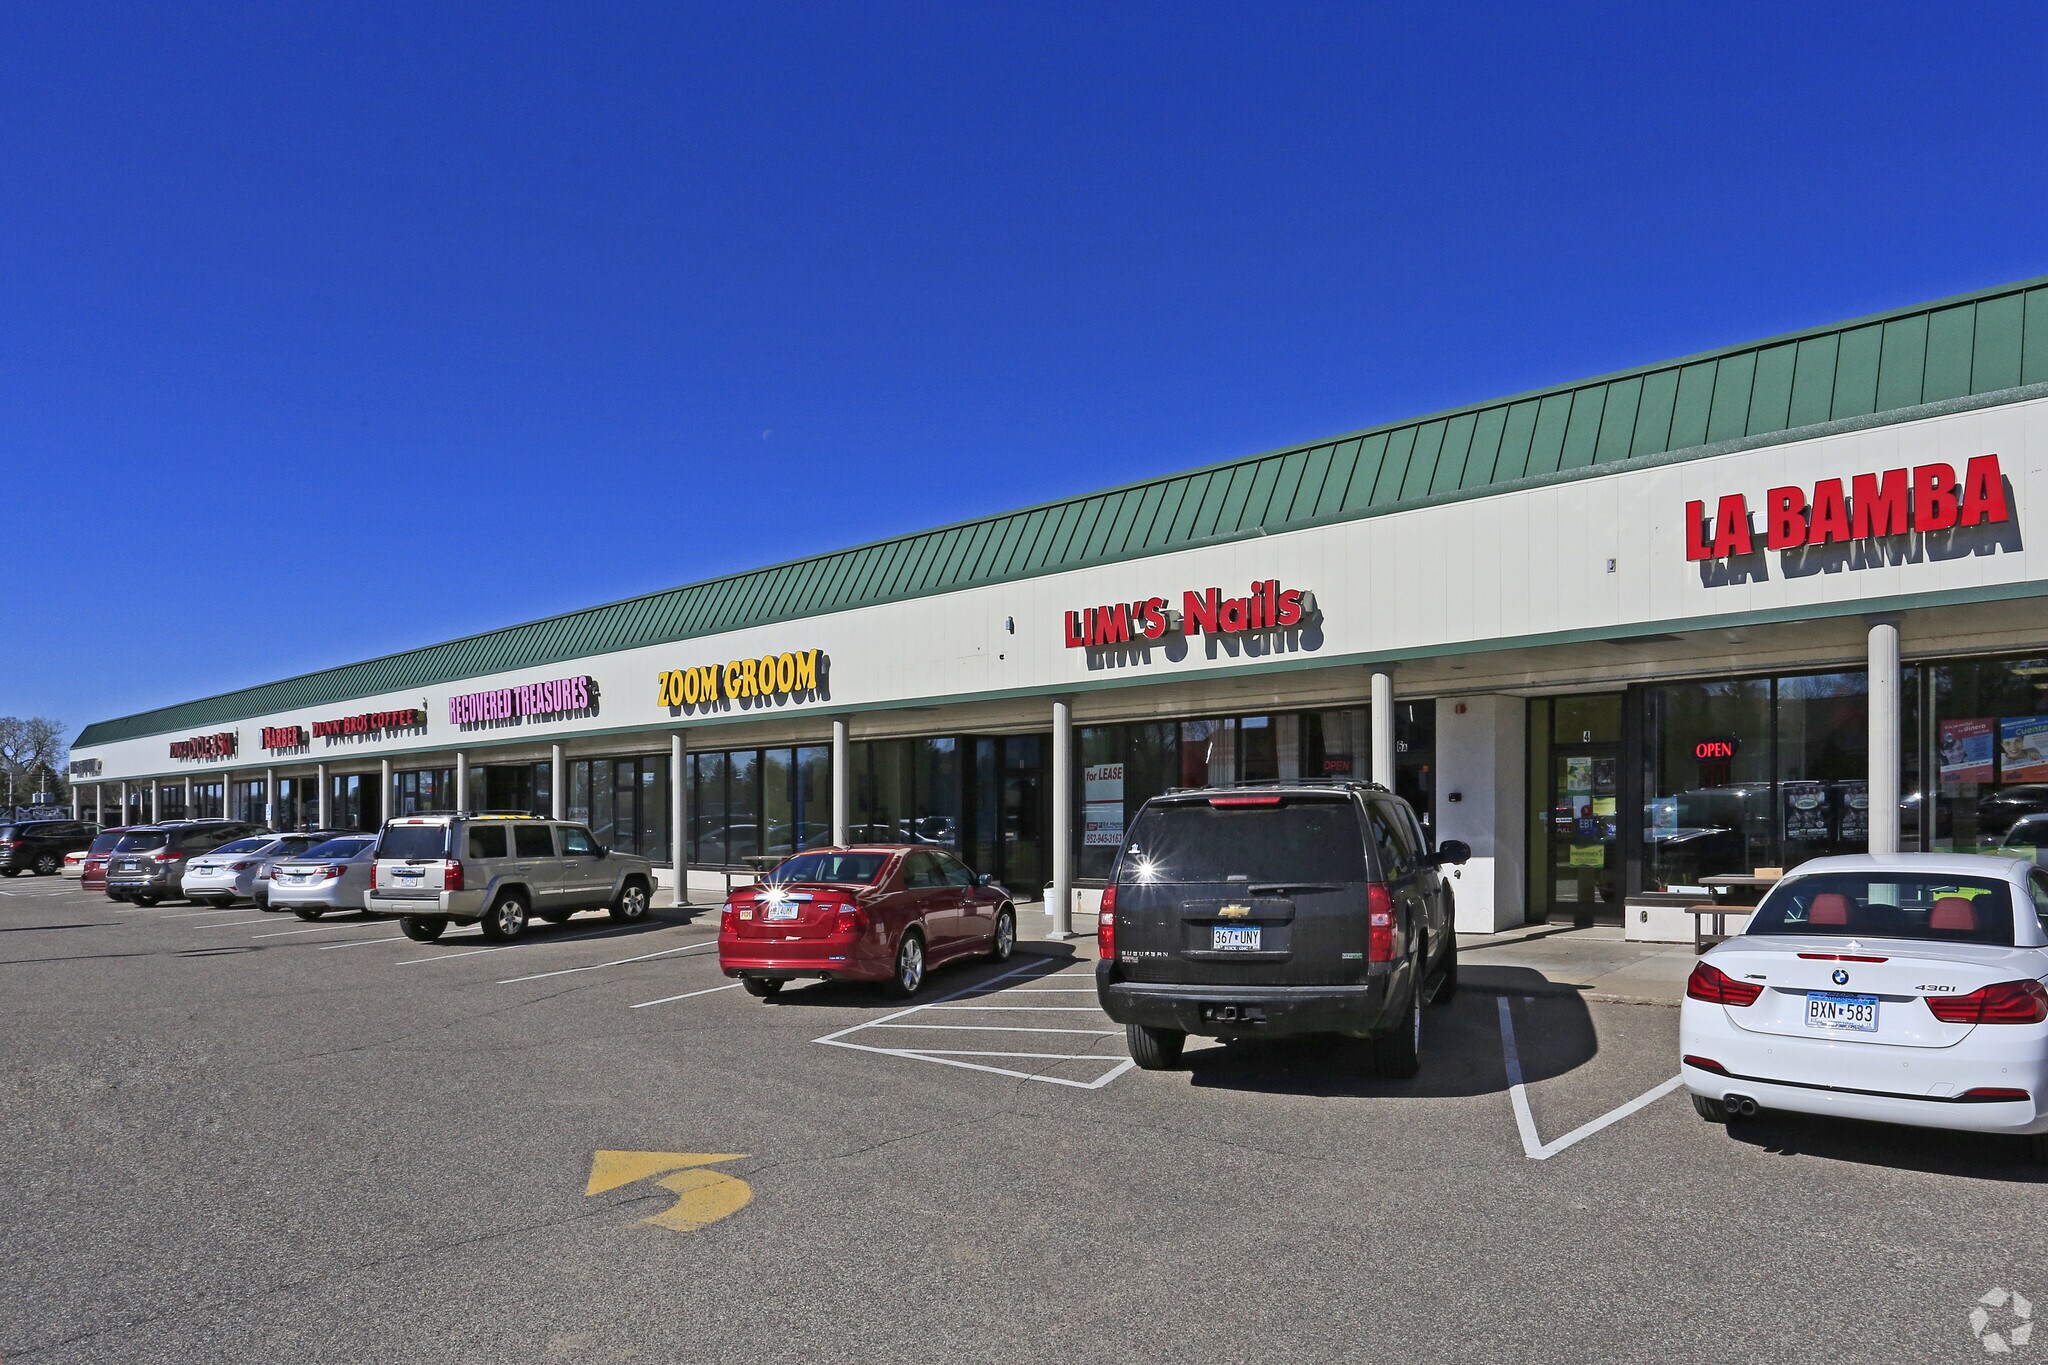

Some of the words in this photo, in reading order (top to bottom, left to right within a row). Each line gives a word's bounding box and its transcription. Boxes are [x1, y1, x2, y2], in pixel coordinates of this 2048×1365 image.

[1686, 493, 1753, 561] LA
[1767, 454, 2009, 551] BAMBA
[1065, 597, 1168, 648] LIM'S
[1183, 579, 1304, 636] Nails
[657, 664, 721, 707] ZOOM
[723, 648, 820, 700] GROOM
[449, 687, 512, 725] RECOVERED
[513, 675, 589, 716] TREASURES
[312, 719, 342, 738] DUNN
[344, 714, 369, 735] BROS
[371, 709, 416, 731] COFFEE
[1963, 724, 1987, 732] dinero
[264, 726, 301, 749] BARBER
[1584, 731, 1590, 741] 4
[1696, 742, 1732, 758] OPEN
[1086, 771, 1097, 781] for
[1098, 766, 1122, 781] LEASE
[1323, 760, 1350, 771] OPEN
[1579, 819, 1594, 828] EBT
[1215, 930, 1233, 944] 367
[1240, 930, 1259, 944] UNY
[1121, 950, 1169, 958] SUBURBAN
[1810, 1001, 1837, 1019] BXN
[1846, 1004, 1873, 1022] 583
